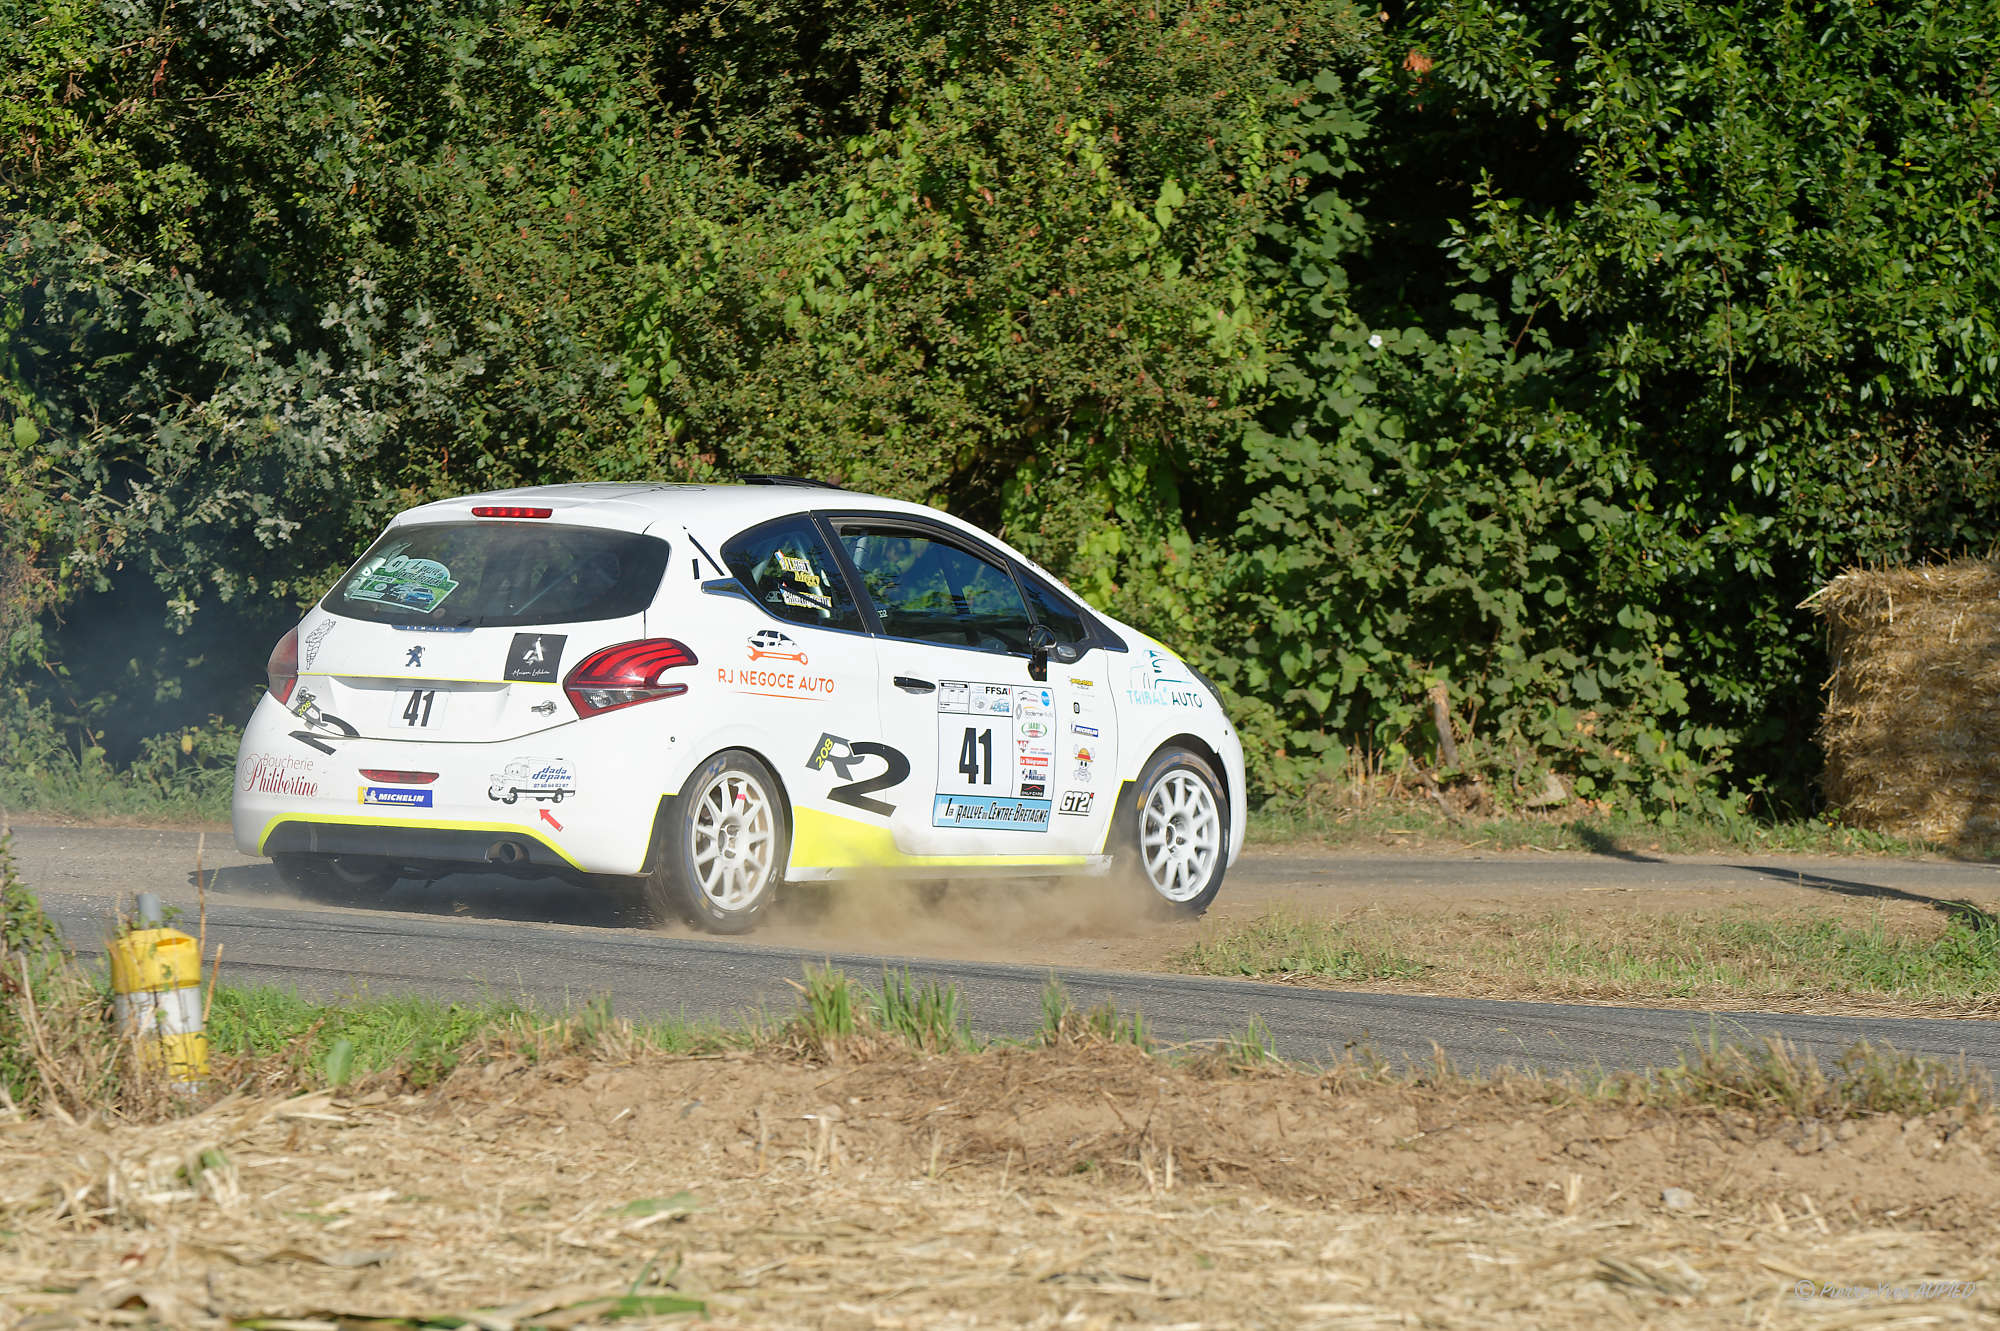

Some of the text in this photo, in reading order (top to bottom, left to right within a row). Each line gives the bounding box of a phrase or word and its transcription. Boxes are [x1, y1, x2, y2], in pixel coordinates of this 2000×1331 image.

[718, 668, 835, 693] RJ NEGOCE AUTO
[985, 686, 1008, 696] FFSA
[403, 689, 436, 727] 41
[1171, 691, 1203, 709] AUTO
[262, 753, 314, 771] Boucherie
[815, 738, 833, 769] 208
[958, 727, 992, 785] 41
[805, 732, 911, 818] R2
[378, 793, 425, 803] MICHELIN
[1059, 790, 1095, 813] GT2i
